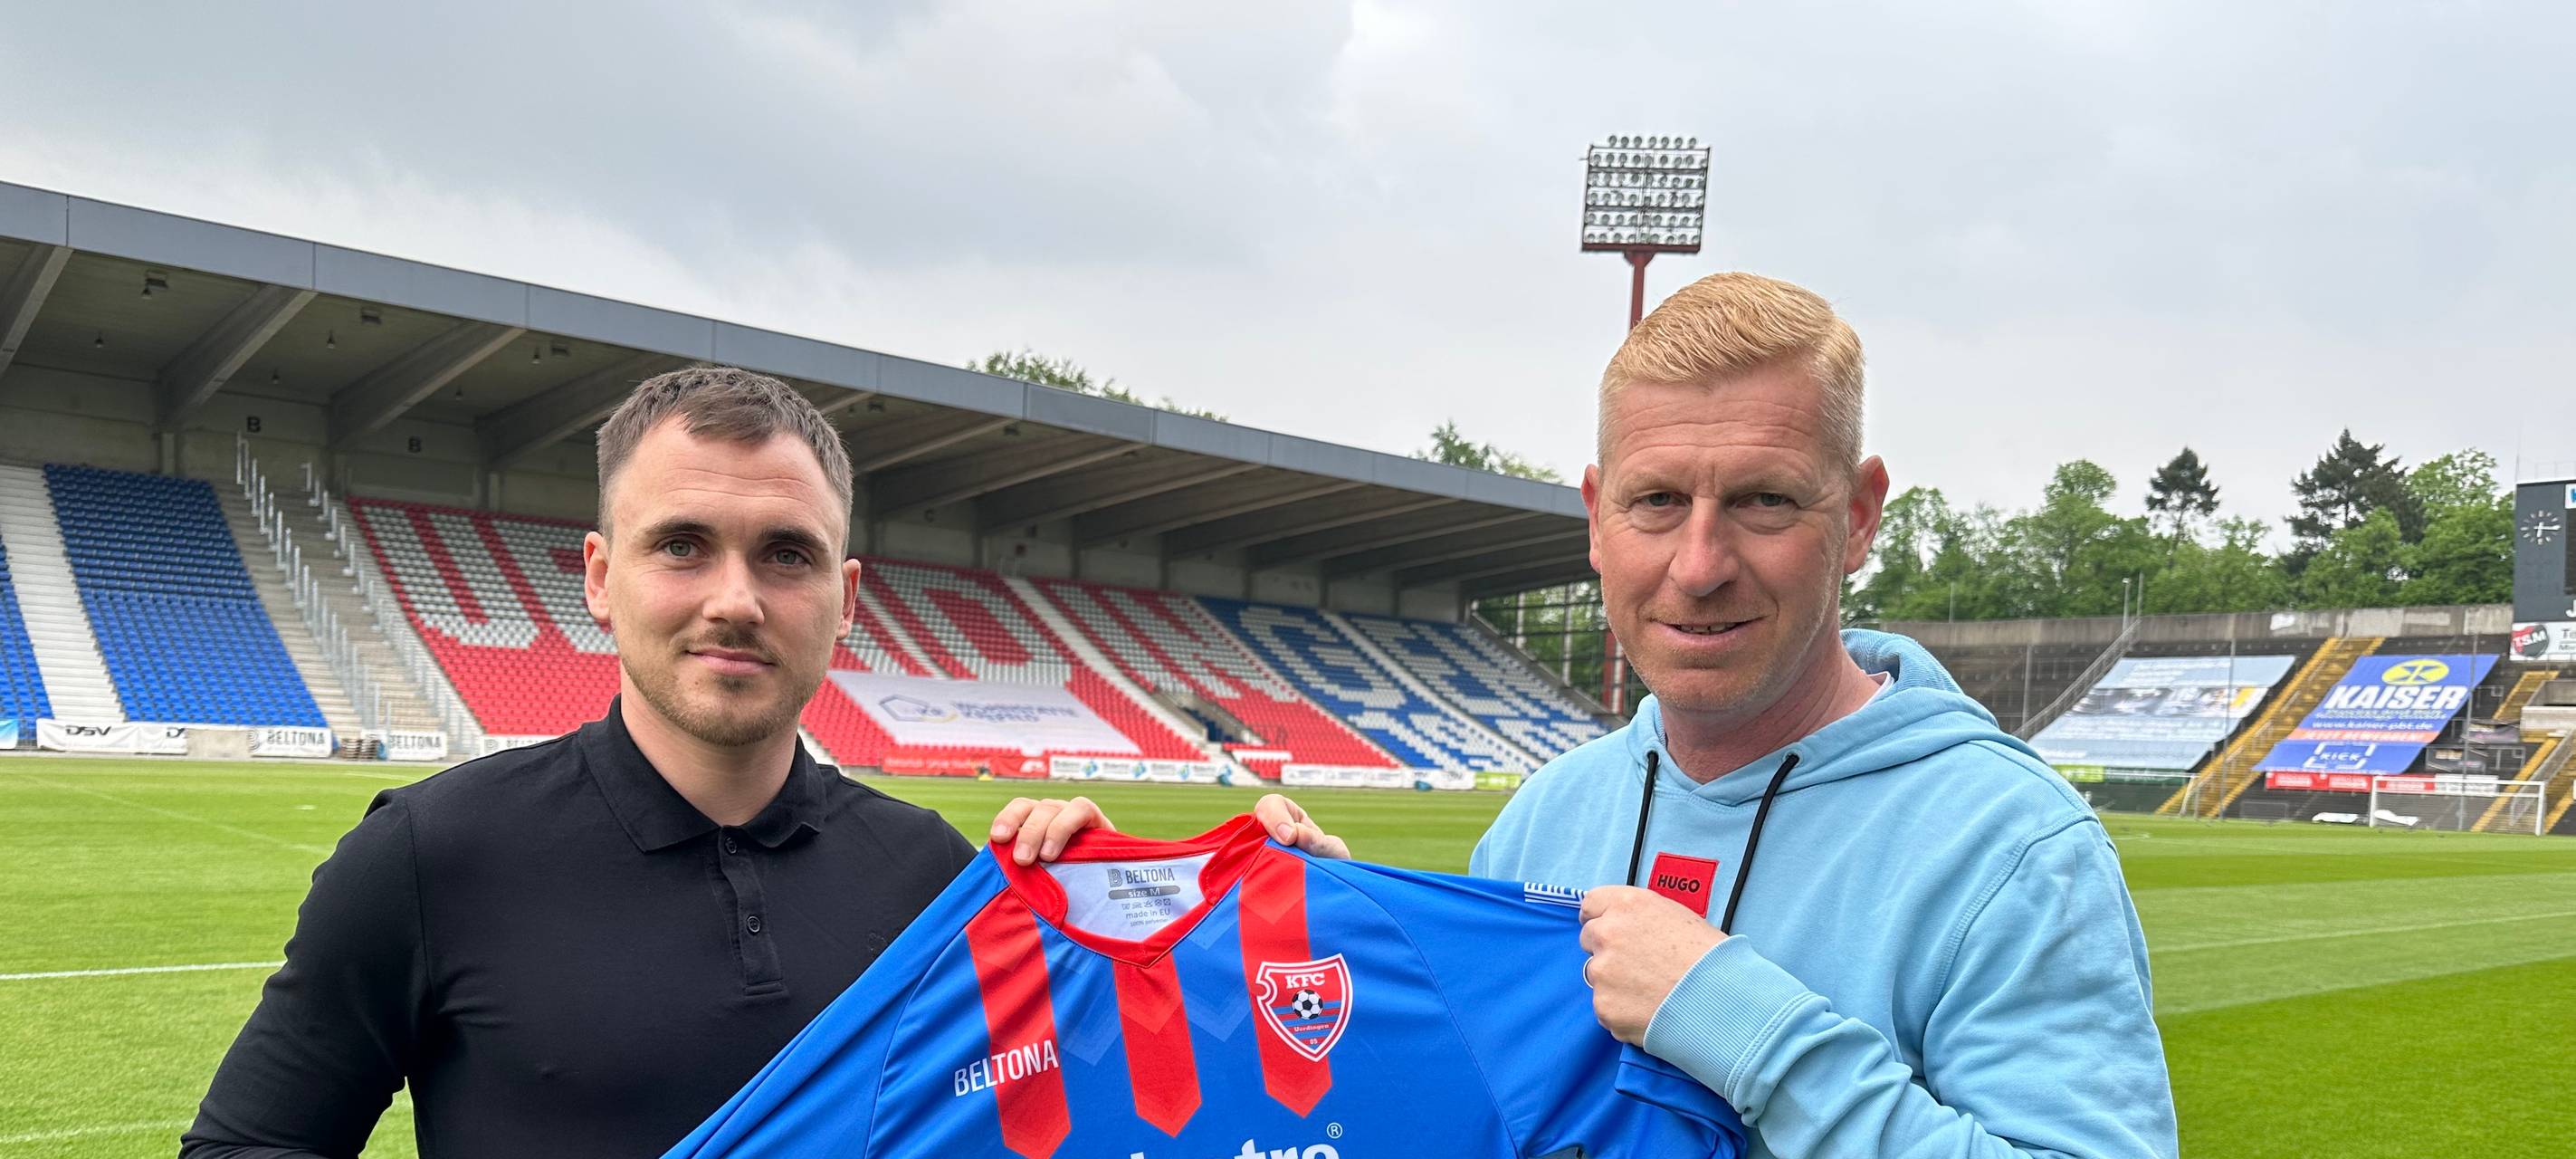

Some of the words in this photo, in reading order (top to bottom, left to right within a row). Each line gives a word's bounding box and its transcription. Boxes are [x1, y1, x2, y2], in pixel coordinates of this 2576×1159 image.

[246, 416, 261, 433] B
[2324, 685, 2468, 709] KAISER
[65, 725, 111, 736] DSV
[267, 730, 325, 746] BELTONA
[1125, 868, 1175, 884] BELTONA
[1128, 889, 1148, 898] size
[1150, 887, 1160, 896] M
[1657, 875, 1701, 894] HUGO
[1125, 911, 1149, 920] made
[1159, 908, 1170, 916] EU
[1285, 972, 1326, 989] KFC
[1294, 1024, 1330, 1032] Uerdingen
[954, 1039, 1059, 1097] BELTONA
